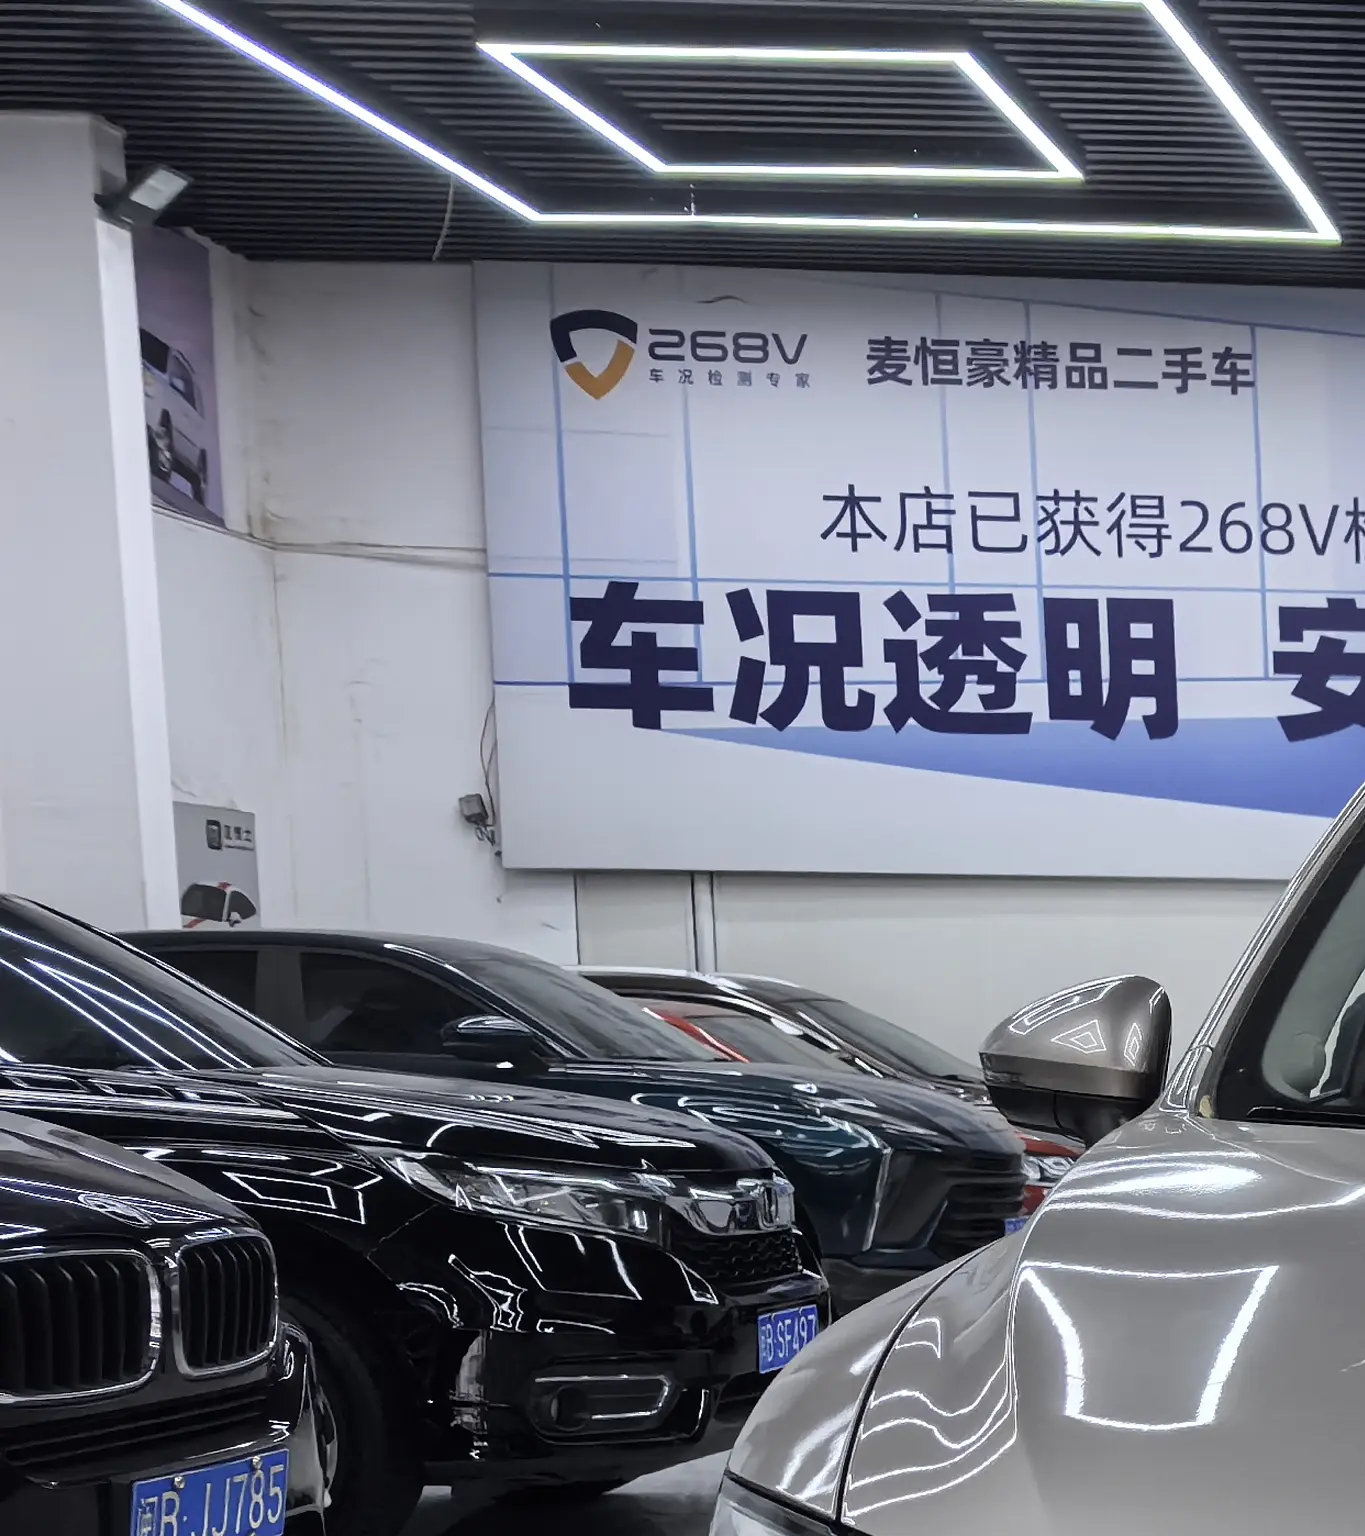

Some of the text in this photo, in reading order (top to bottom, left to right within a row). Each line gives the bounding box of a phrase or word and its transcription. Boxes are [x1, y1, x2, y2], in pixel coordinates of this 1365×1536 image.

[648, 328, 808, 366] 268V
[867, 337, 1256, 395] 麦恒豪精品二手车
[649, 368, 811, 389] 车况检测专家
[568, 581, 1178, 741] 车况透明
